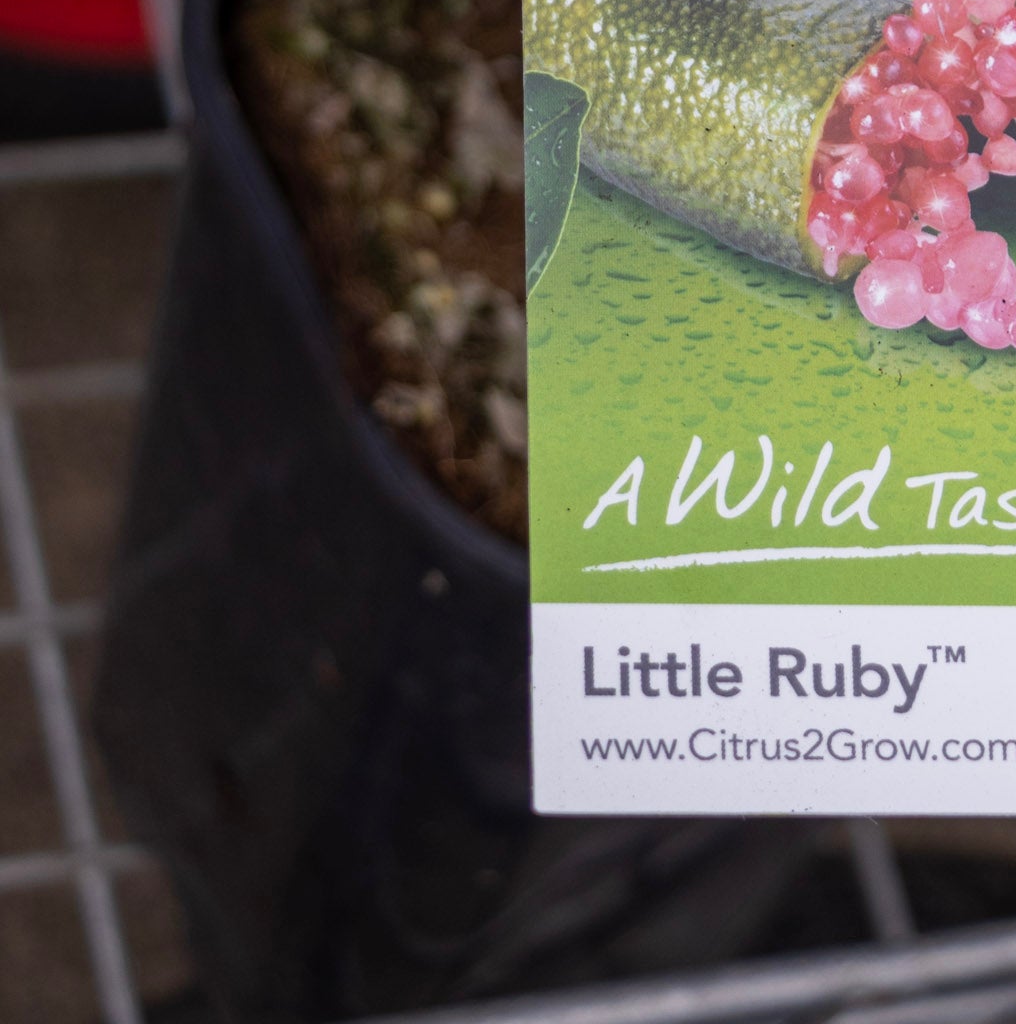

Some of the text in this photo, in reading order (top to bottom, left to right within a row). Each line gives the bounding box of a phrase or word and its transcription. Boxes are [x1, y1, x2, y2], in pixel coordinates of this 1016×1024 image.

[583, 456, 645, 530] A
[665, 435, 892, 530] Wild
[583, 643, 743, 697] Little
